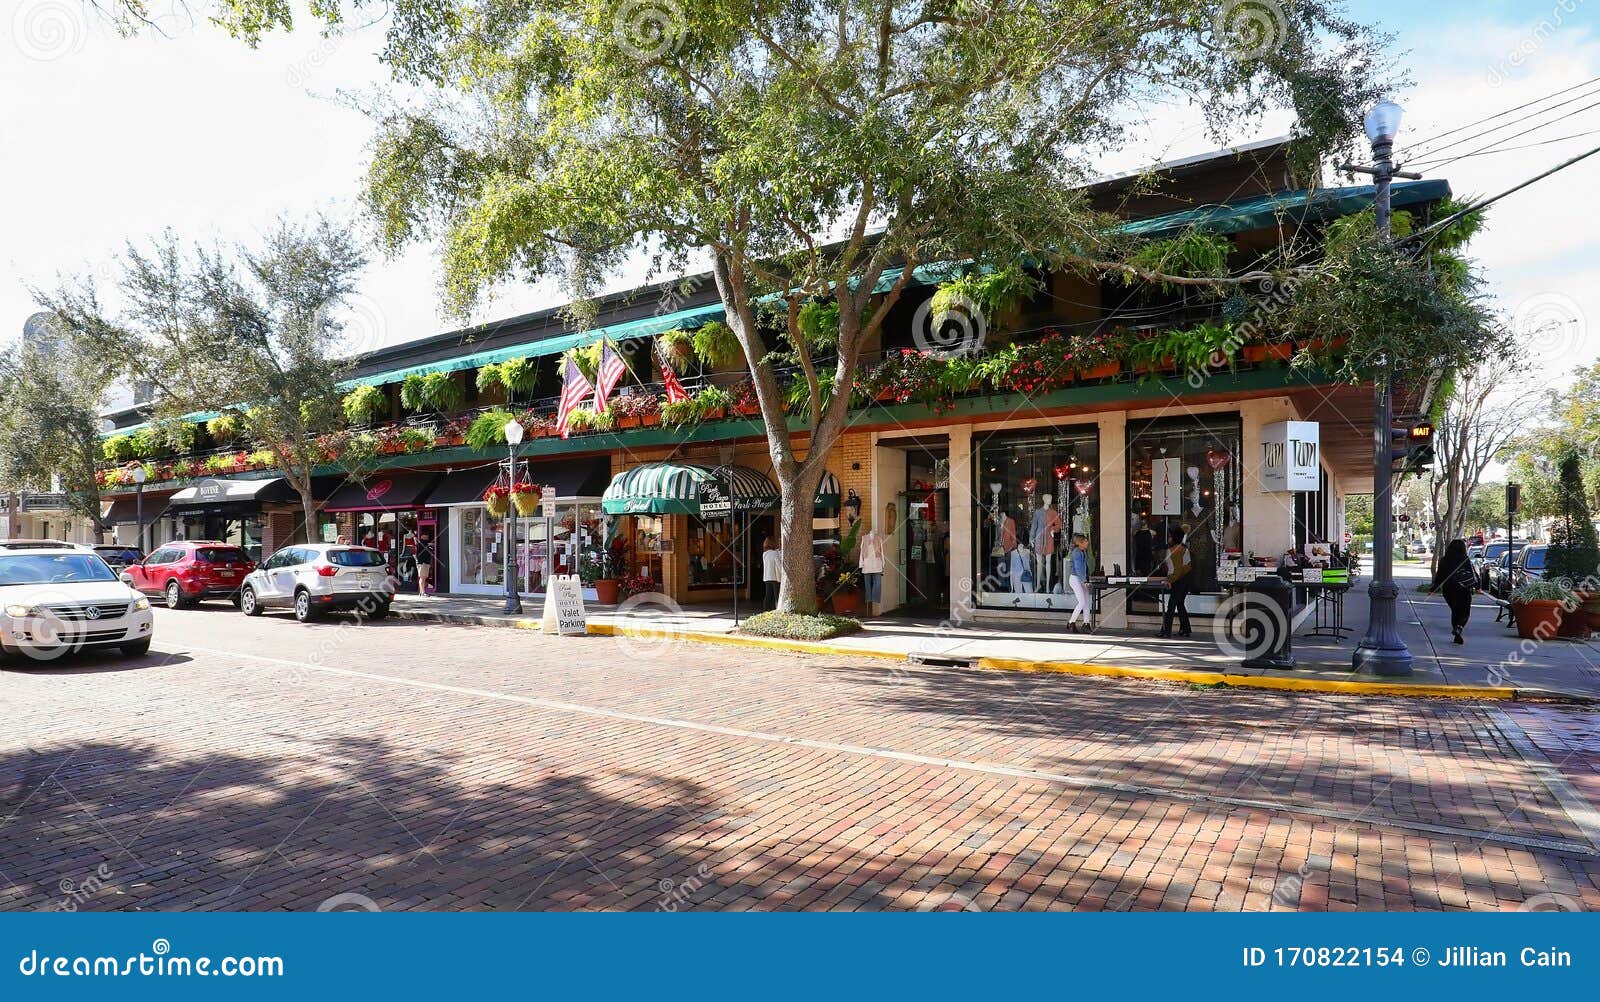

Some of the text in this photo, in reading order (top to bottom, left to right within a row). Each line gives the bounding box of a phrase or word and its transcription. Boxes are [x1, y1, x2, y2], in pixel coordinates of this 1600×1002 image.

[1413, 427, 1430, 436] WAIT
[699, 483, 719, 494] Park
[562, 609, 580, 617] Valet
[559, 619, 586, 629] Parking
